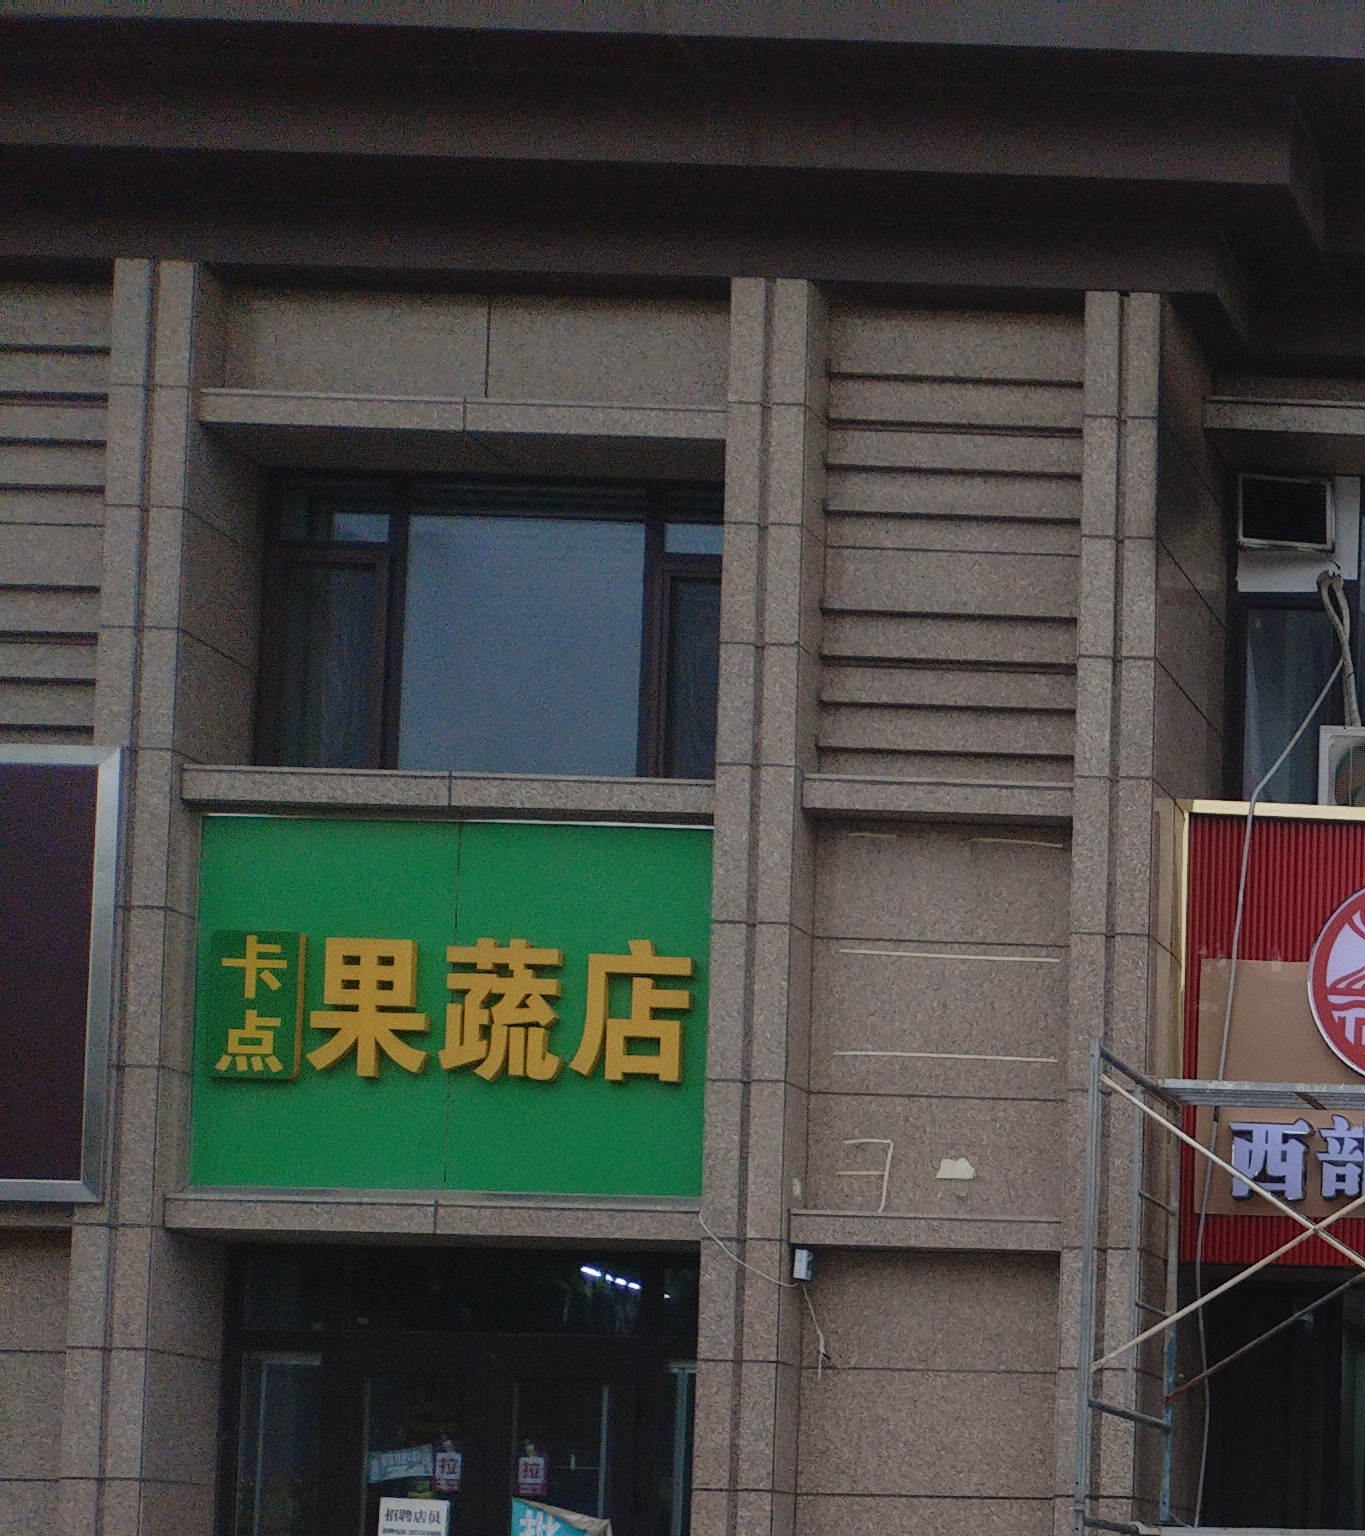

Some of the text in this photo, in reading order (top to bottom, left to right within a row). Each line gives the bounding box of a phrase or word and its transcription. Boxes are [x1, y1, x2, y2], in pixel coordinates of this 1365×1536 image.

[215, 935, 289, 1074] 卡点
[308, 936, 695, 1083] 果蔬店
